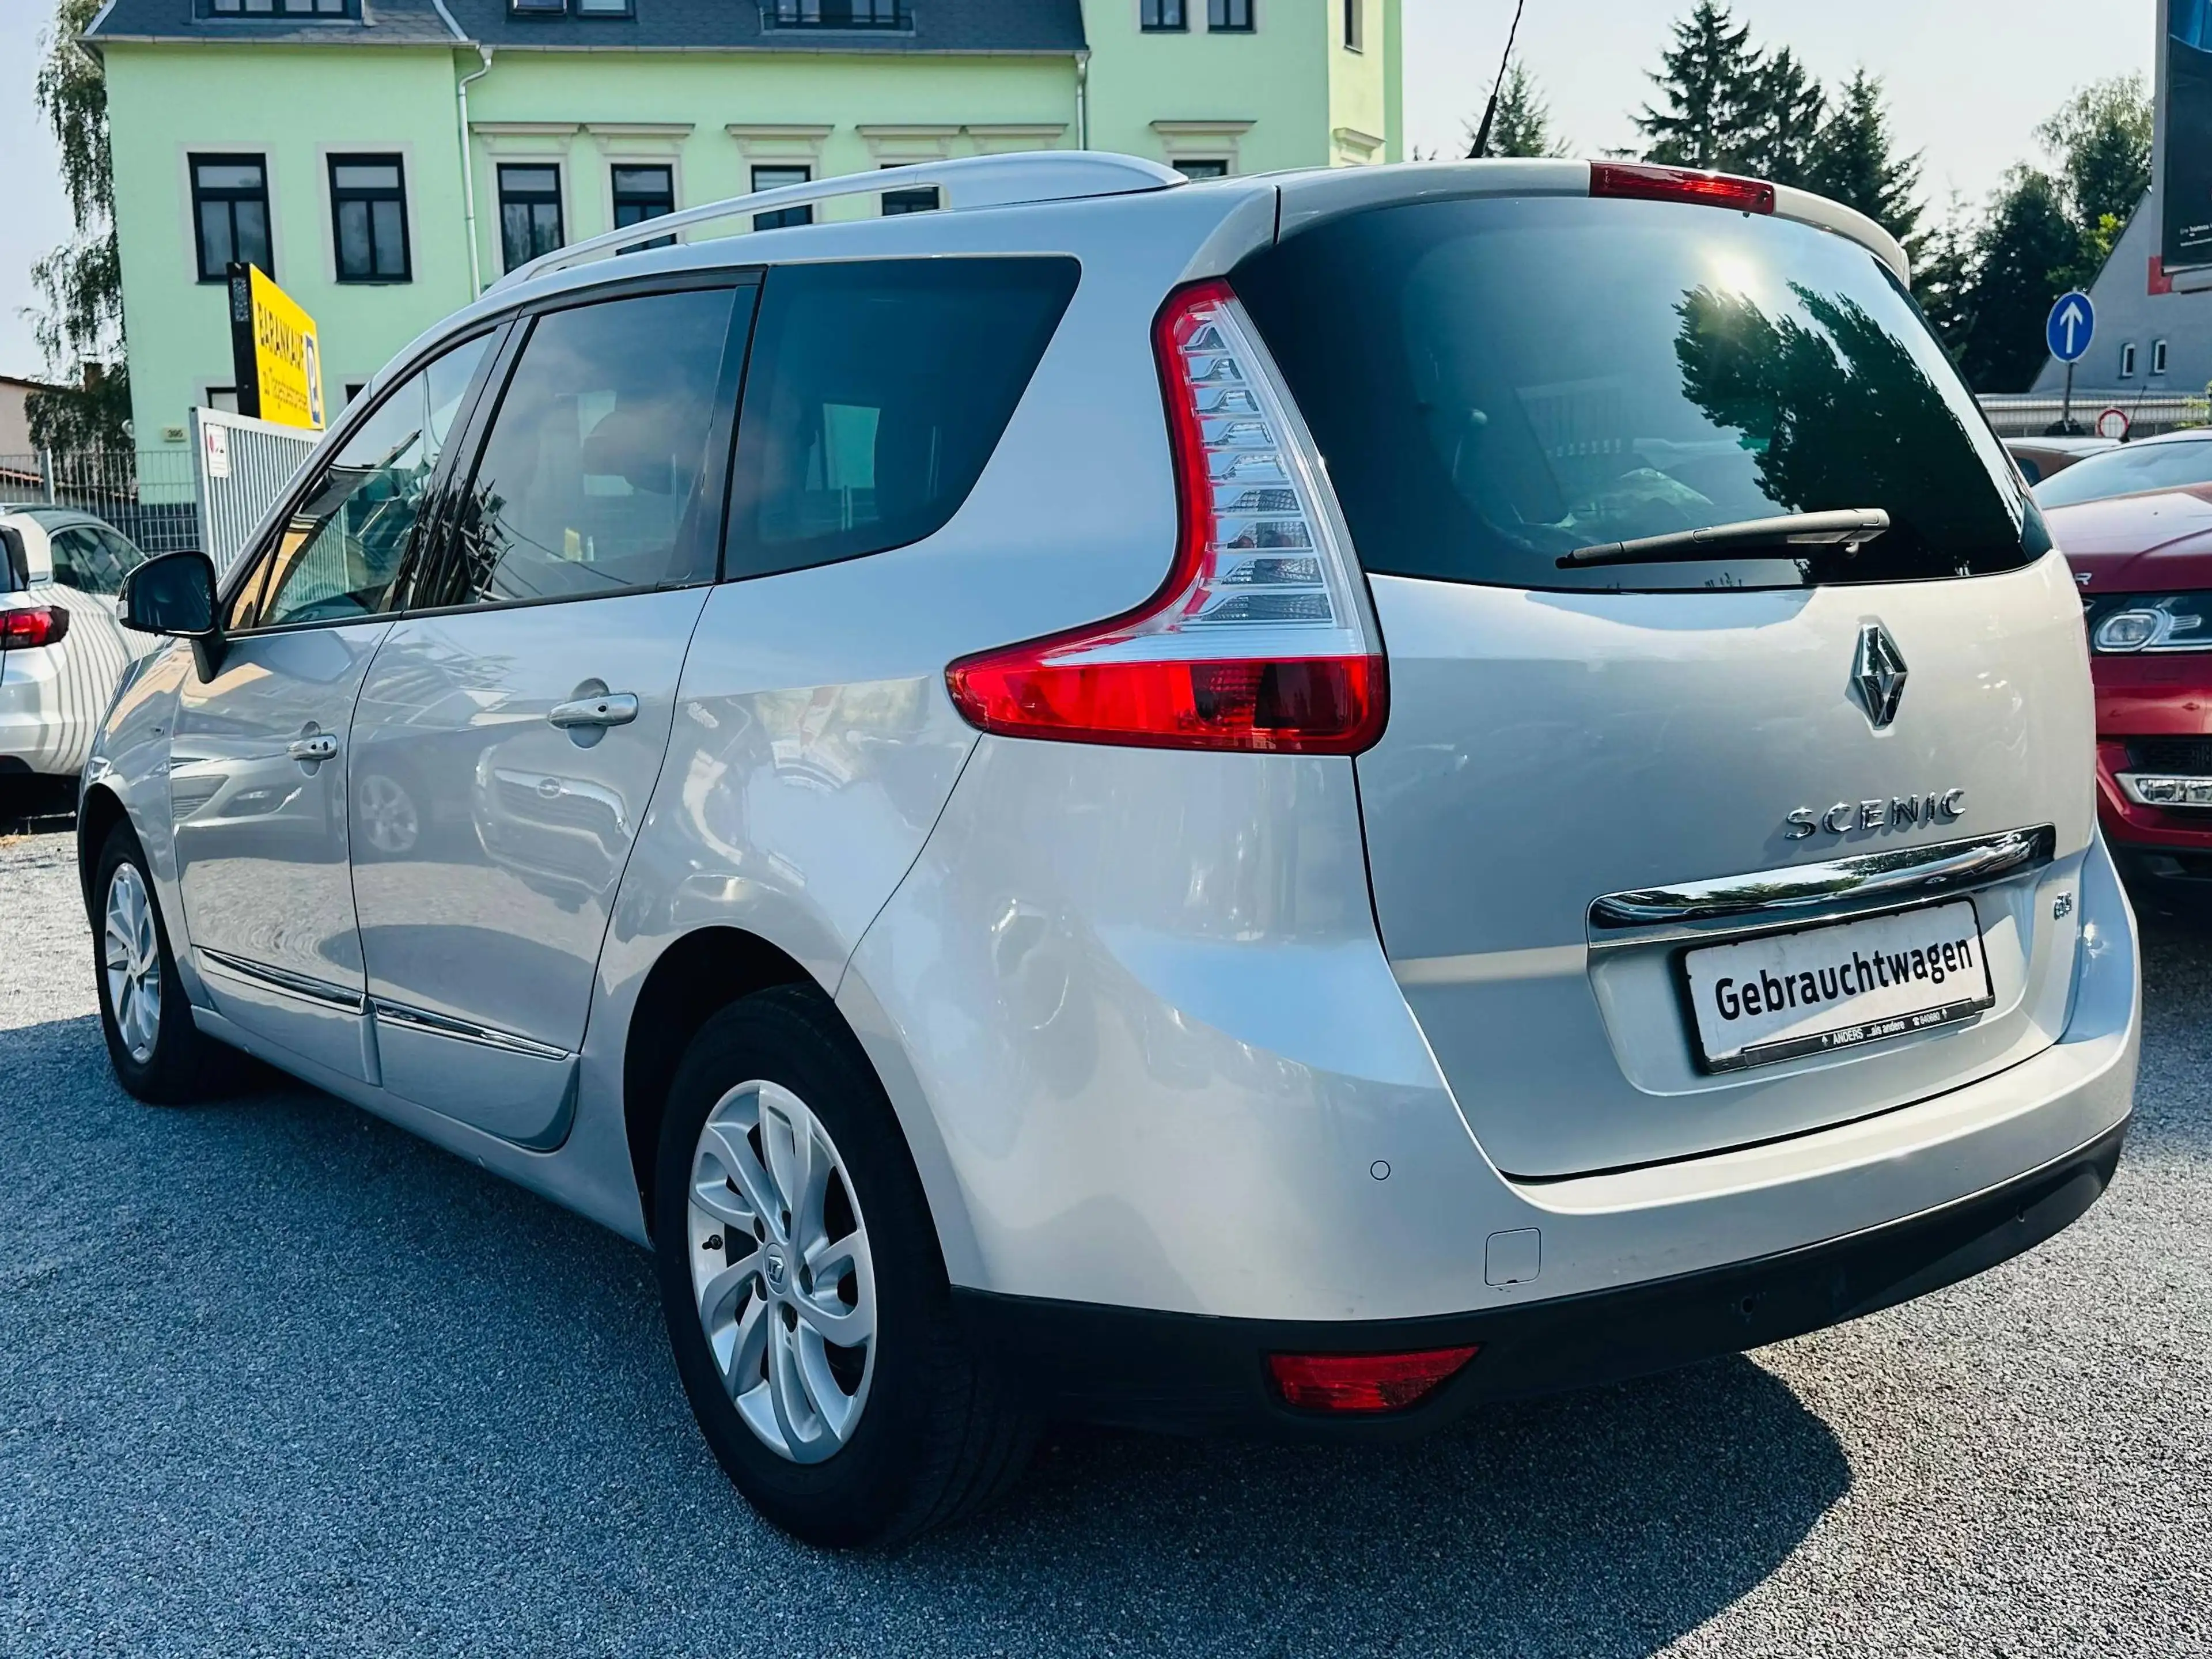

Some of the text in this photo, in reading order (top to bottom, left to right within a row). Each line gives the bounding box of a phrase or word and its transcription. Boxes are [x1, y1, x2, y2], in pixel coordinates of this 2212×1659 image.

[1785, 787, 1965, 839] SCENIC
[1715, 938, 1973, 1021] Gebrauchtwagen
[1833, 1027, 1864, 1045] ANDERS
[1882, 1020, 1905, 1033] andere
